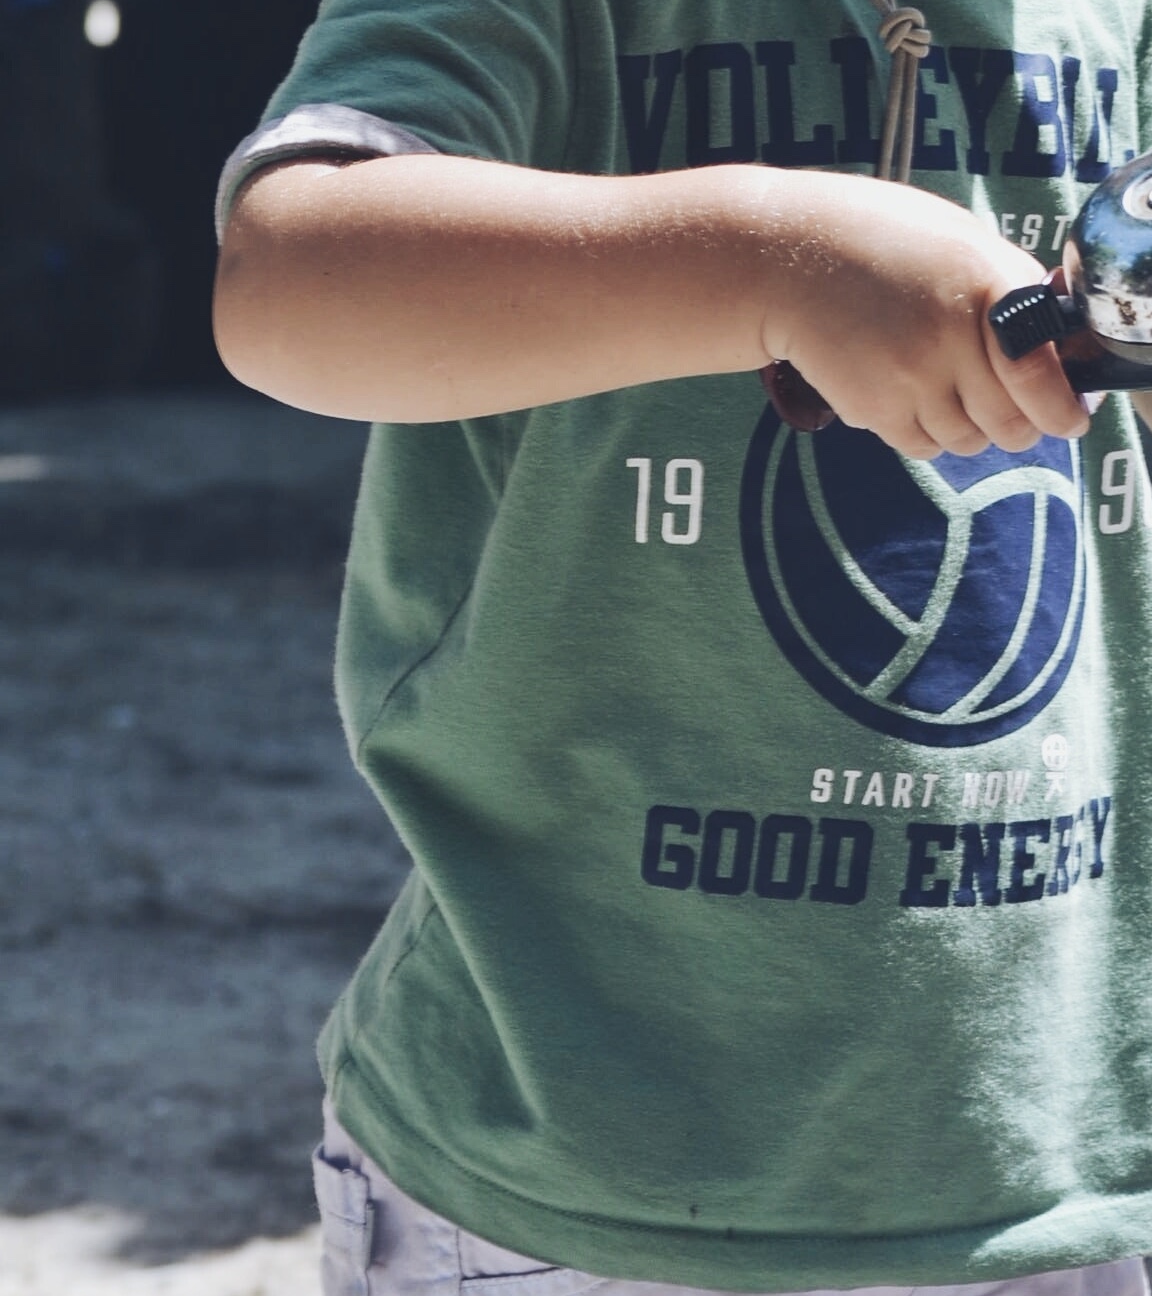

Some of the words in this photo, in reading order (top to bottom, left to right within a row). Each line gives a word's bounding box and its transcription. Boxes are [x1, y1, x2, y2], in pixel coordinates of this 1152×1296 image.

[625, 457, 704, 545] 19
[810, 767, 940, 808] START
[961, 769, 1031, 808] NOW
[641, 804, 875, 905] GOOD
